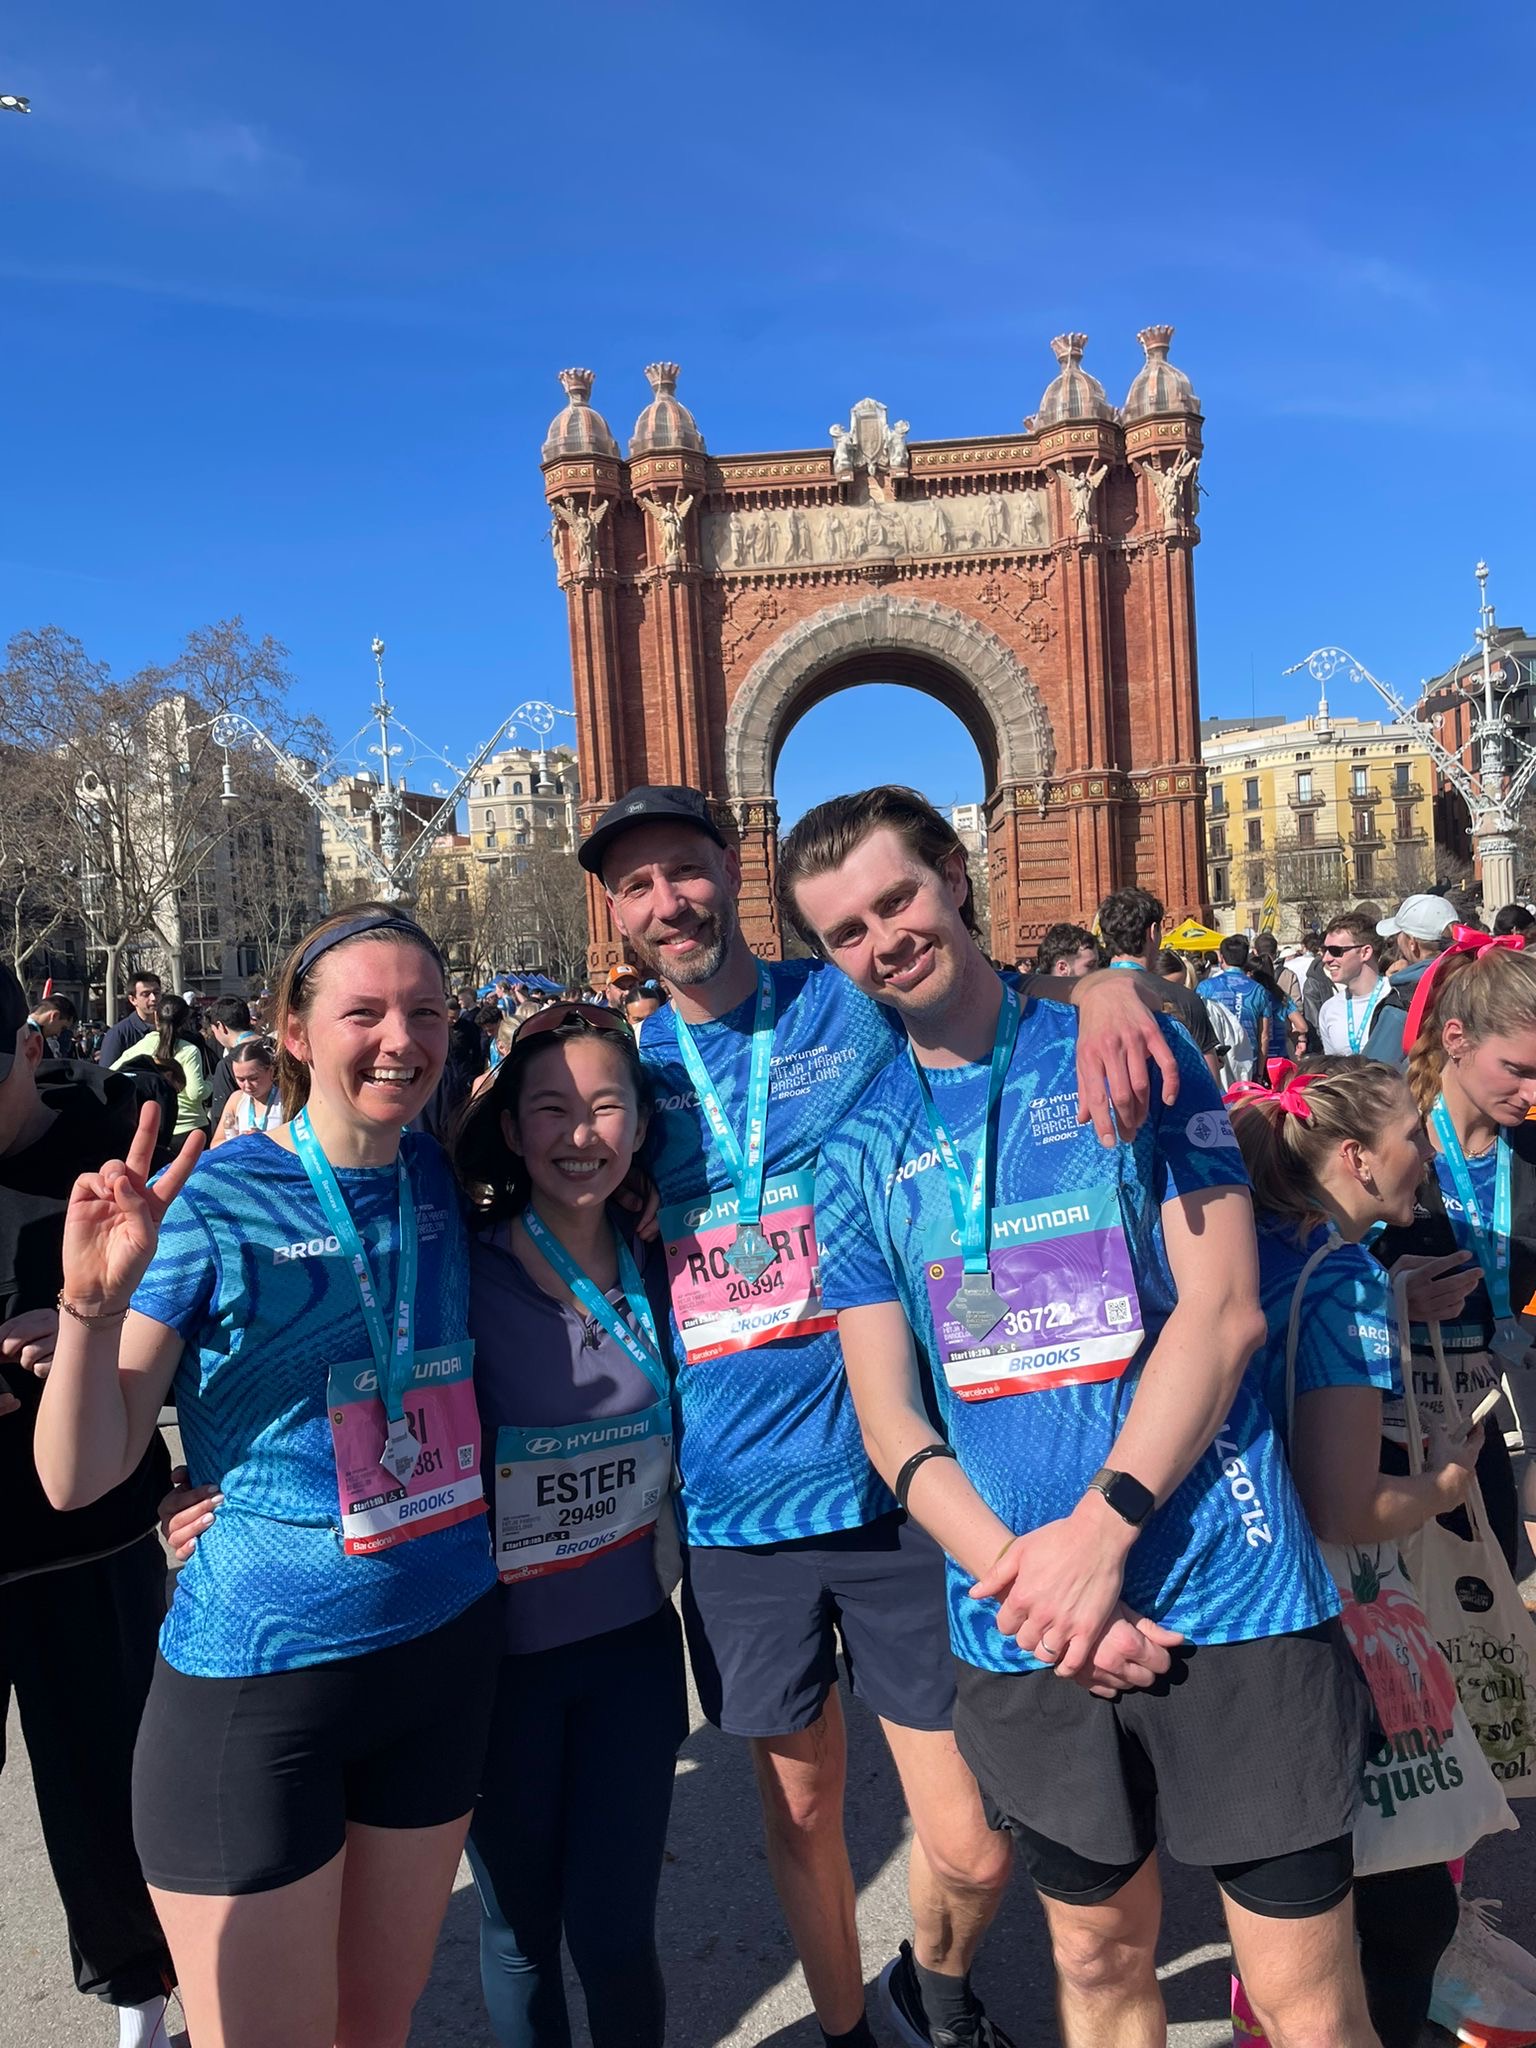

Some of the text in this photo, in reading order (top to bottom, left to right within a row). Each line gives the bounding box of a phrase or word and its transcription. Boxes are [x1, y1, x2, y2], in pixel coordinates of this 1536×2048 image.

[785, 1045, 828, 1063] HYUNDAI
[771, 1067, 841, 1094] BARCELONA
[778, 1086, 811, 1099] BROOKS
[1030, 1104, 1070, 1124] MITJA
[1042, 1131, 1078, 1145] BROOKS
[992, 1205, 1090, 1239] HYUNDAI
[726, 1270, 785, 1303] 20394
[1003, 1302, 1074, 1336] 36722
[1008, 1346, 1080, 1373] BROOKS
[566, 1419, 649, 1450] HYUNDAI
[536, 1457, 637, 1507] ESTER
[400, 1489, 455, 1519] BROOKS
[558, 1496, 617, 1527] 29490
[555, 1530, 618, 1556] BROOKS
[1363, 1754, 1464, 1818] quets
